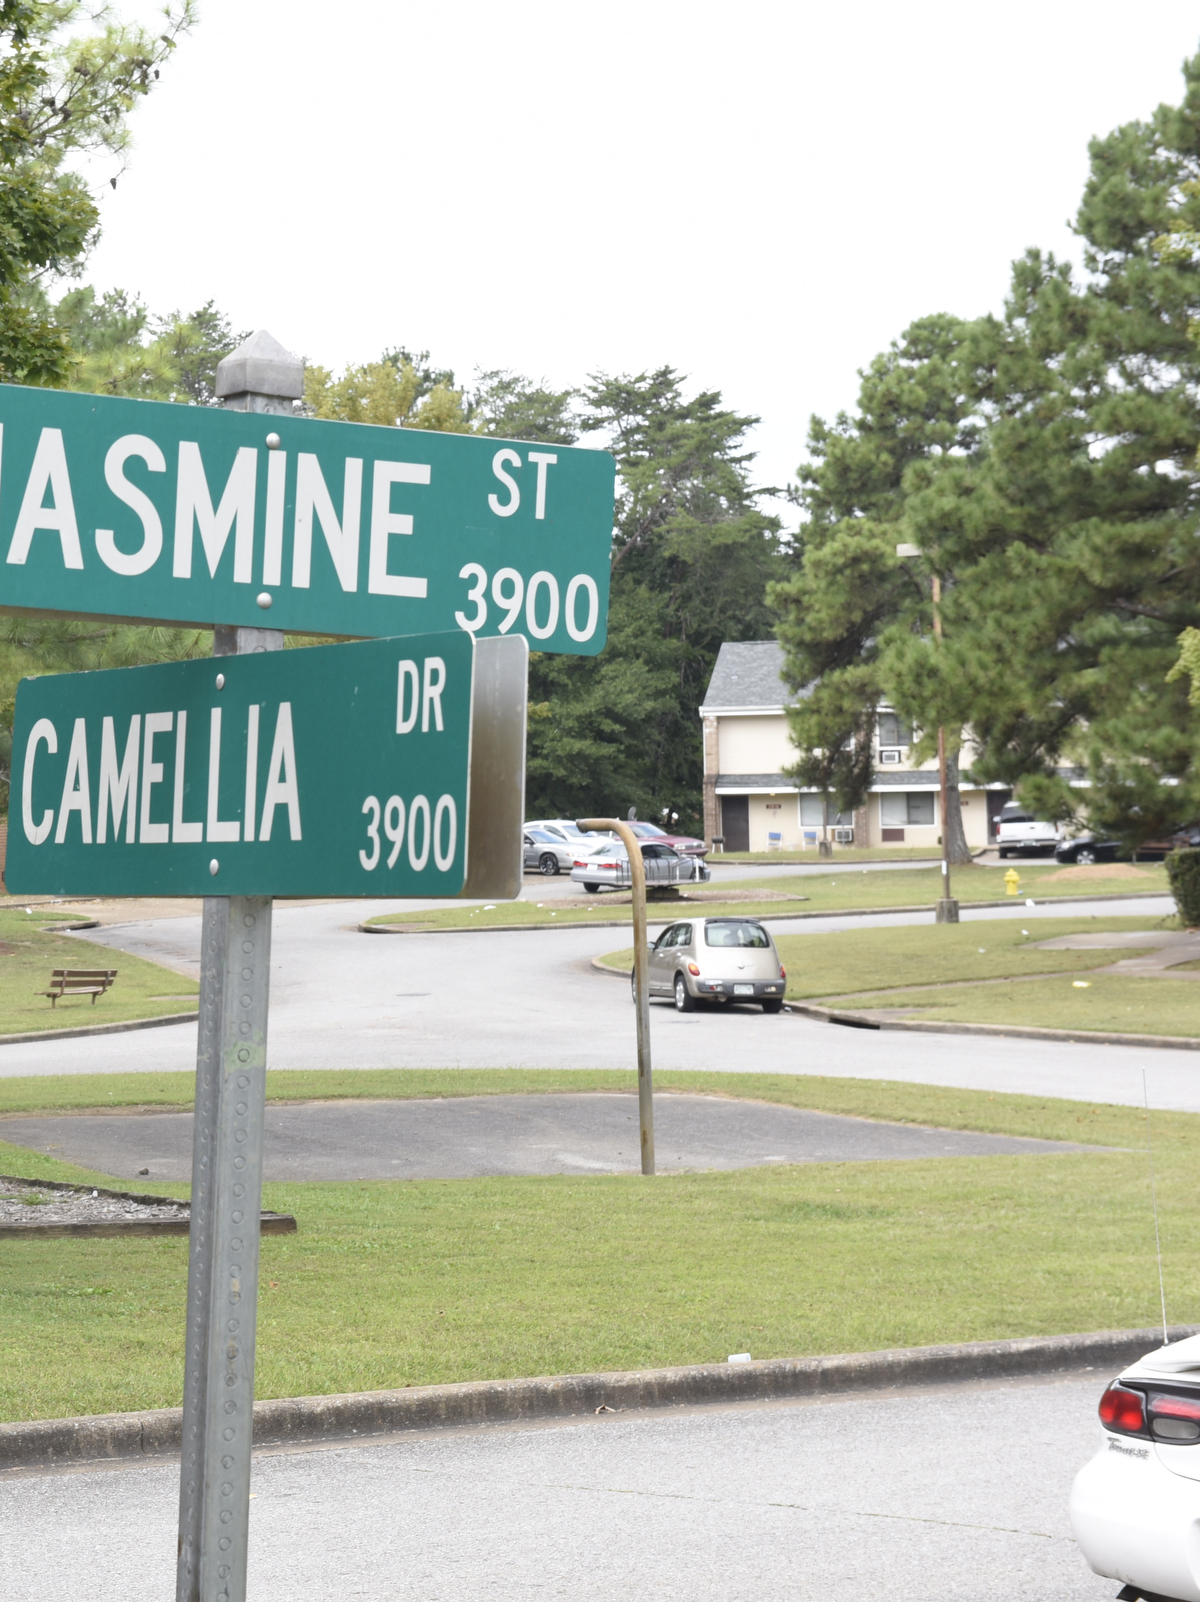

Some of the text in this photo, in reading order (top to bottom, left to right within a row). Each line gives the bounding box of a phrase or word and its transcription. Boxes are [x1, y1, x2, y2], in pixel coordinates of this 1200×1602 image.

[487, 447, 559, 521] ST
[454, 562, 600, 643] 3900
[395, 656, 447, 735] DR
[21, 701, 303, 846] CAMELLIA
[358, 793, 458, 873] 3900
